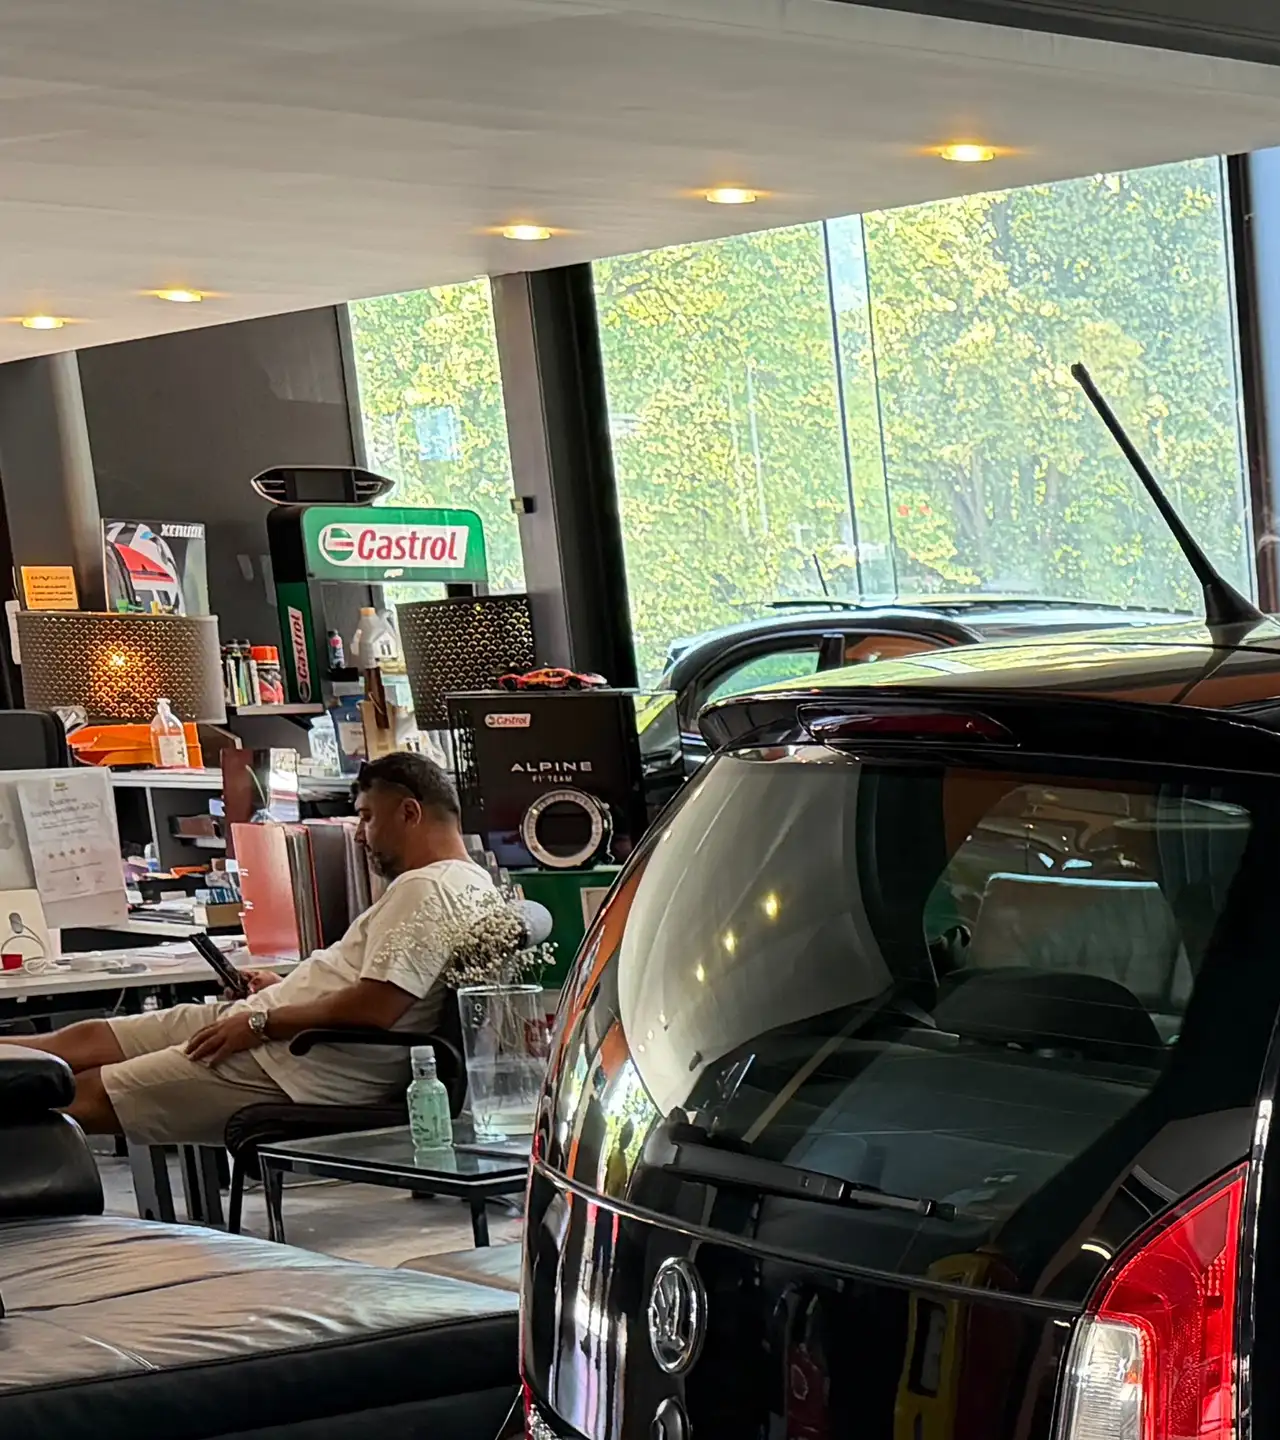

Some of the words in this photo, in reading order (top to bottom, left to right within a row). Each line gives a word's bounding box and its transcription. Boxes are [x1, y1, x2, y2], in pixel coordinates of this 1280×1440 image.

[357, 529, 458, 561] Castrol
[290, 613, 310, 680] Castrol
[496, 716, 528, 726] Castrol
[511, 761, 593, 773] ALPINE
